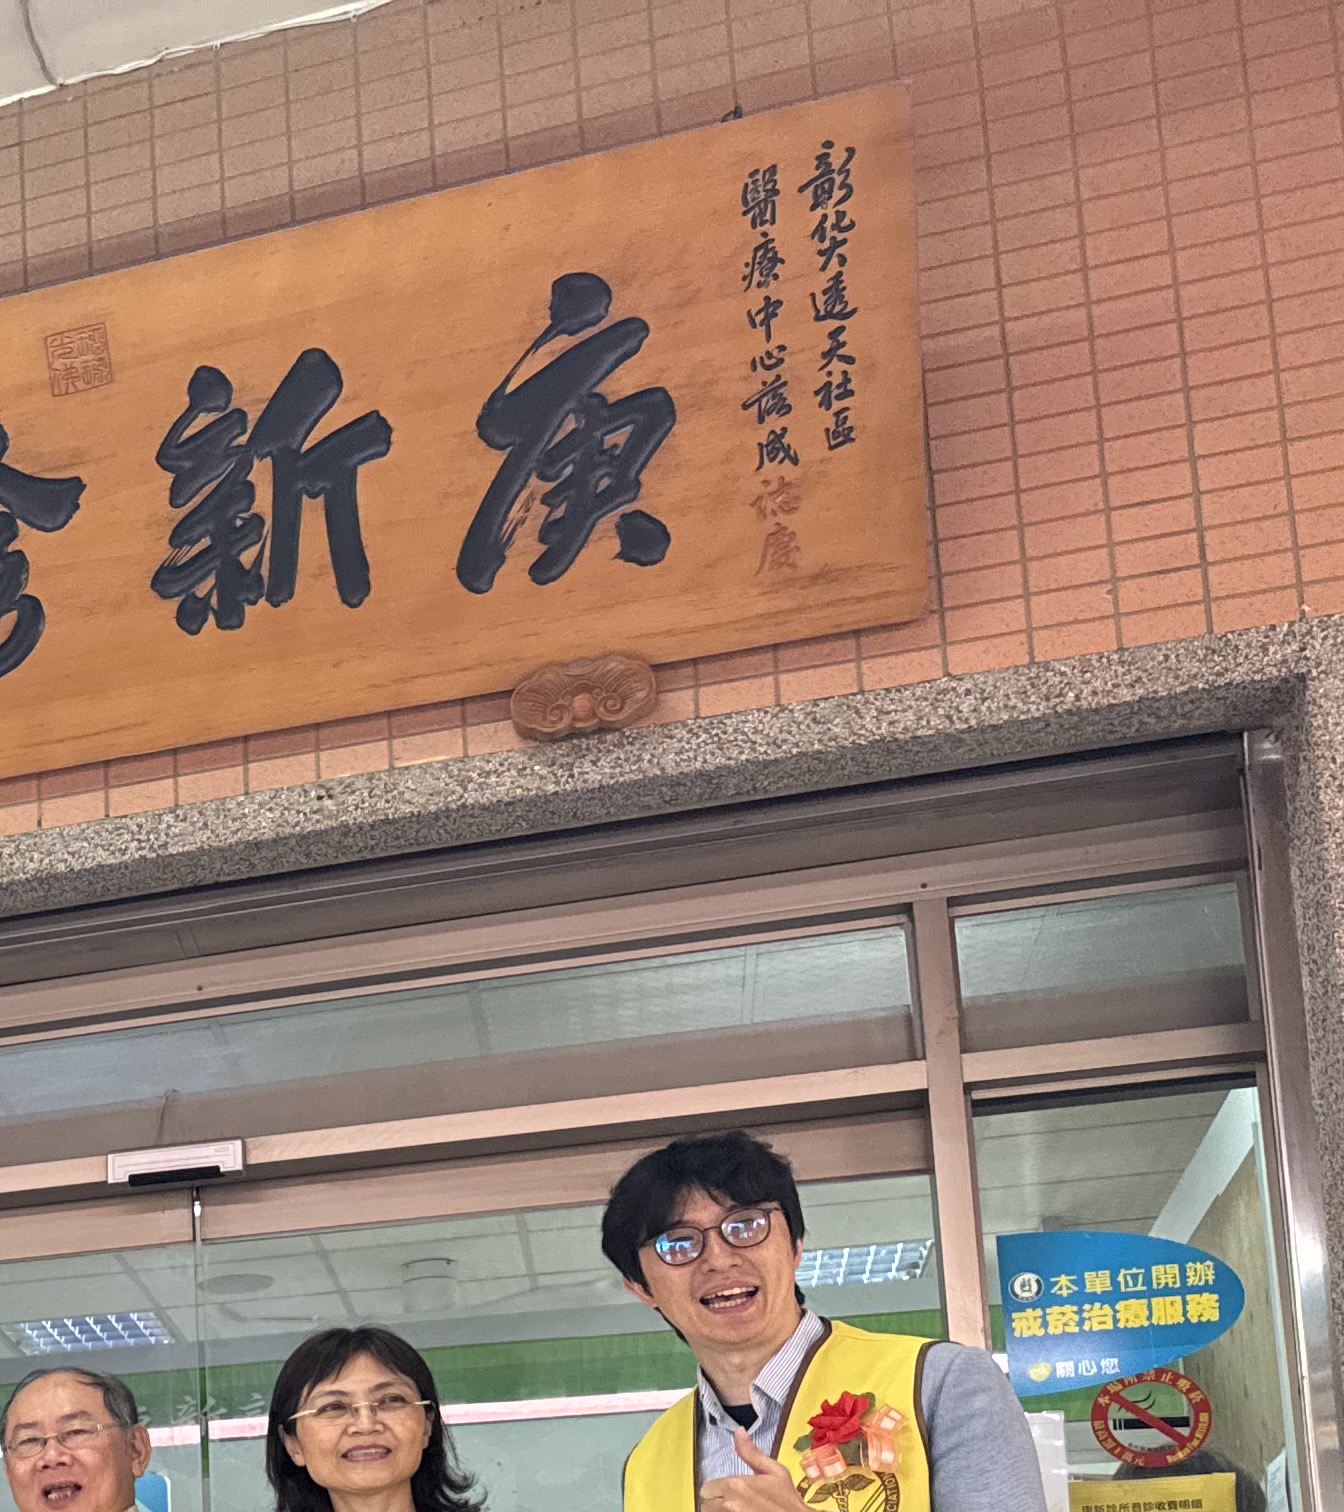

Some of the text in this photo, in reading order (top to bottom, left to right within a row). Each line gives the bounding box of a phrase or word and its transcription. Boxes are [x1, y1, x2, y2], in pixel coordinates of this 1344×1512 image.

[1049, 1260, 1216, 1298] 本單位開辦
[1012, 1292, 1221, 1338] 戒菸治療服務
[1055, 1357, 1120, 1379] 關心您
